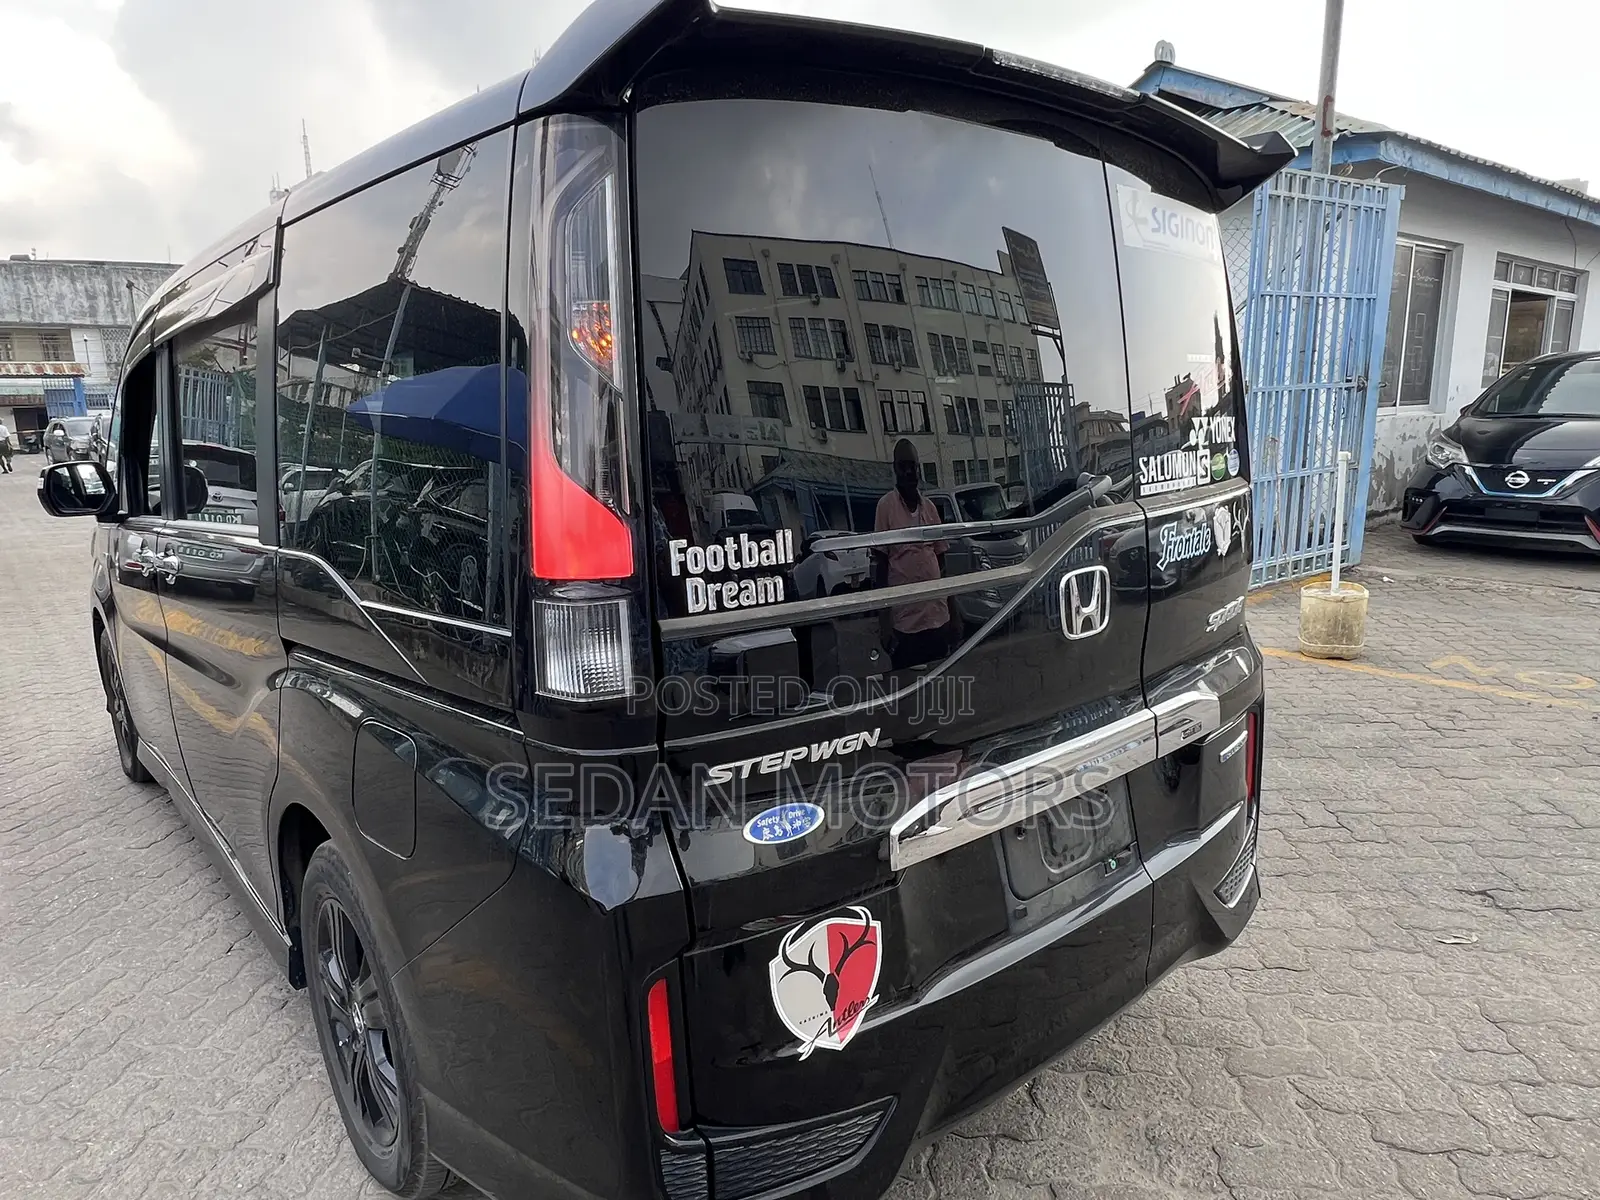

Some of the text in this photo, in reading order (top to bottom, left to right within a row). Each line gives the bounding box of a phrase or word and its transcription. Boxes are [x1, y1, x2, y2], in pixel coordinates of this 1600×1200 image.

[1210, 416, 1236, 444] YONEX
[668, 528, 795, 577] Football
[1156, 521, 1211, 571] Frontale
[685, 574, 785, 614] Dream
[756, 809, 806, 828] Safety Drive
